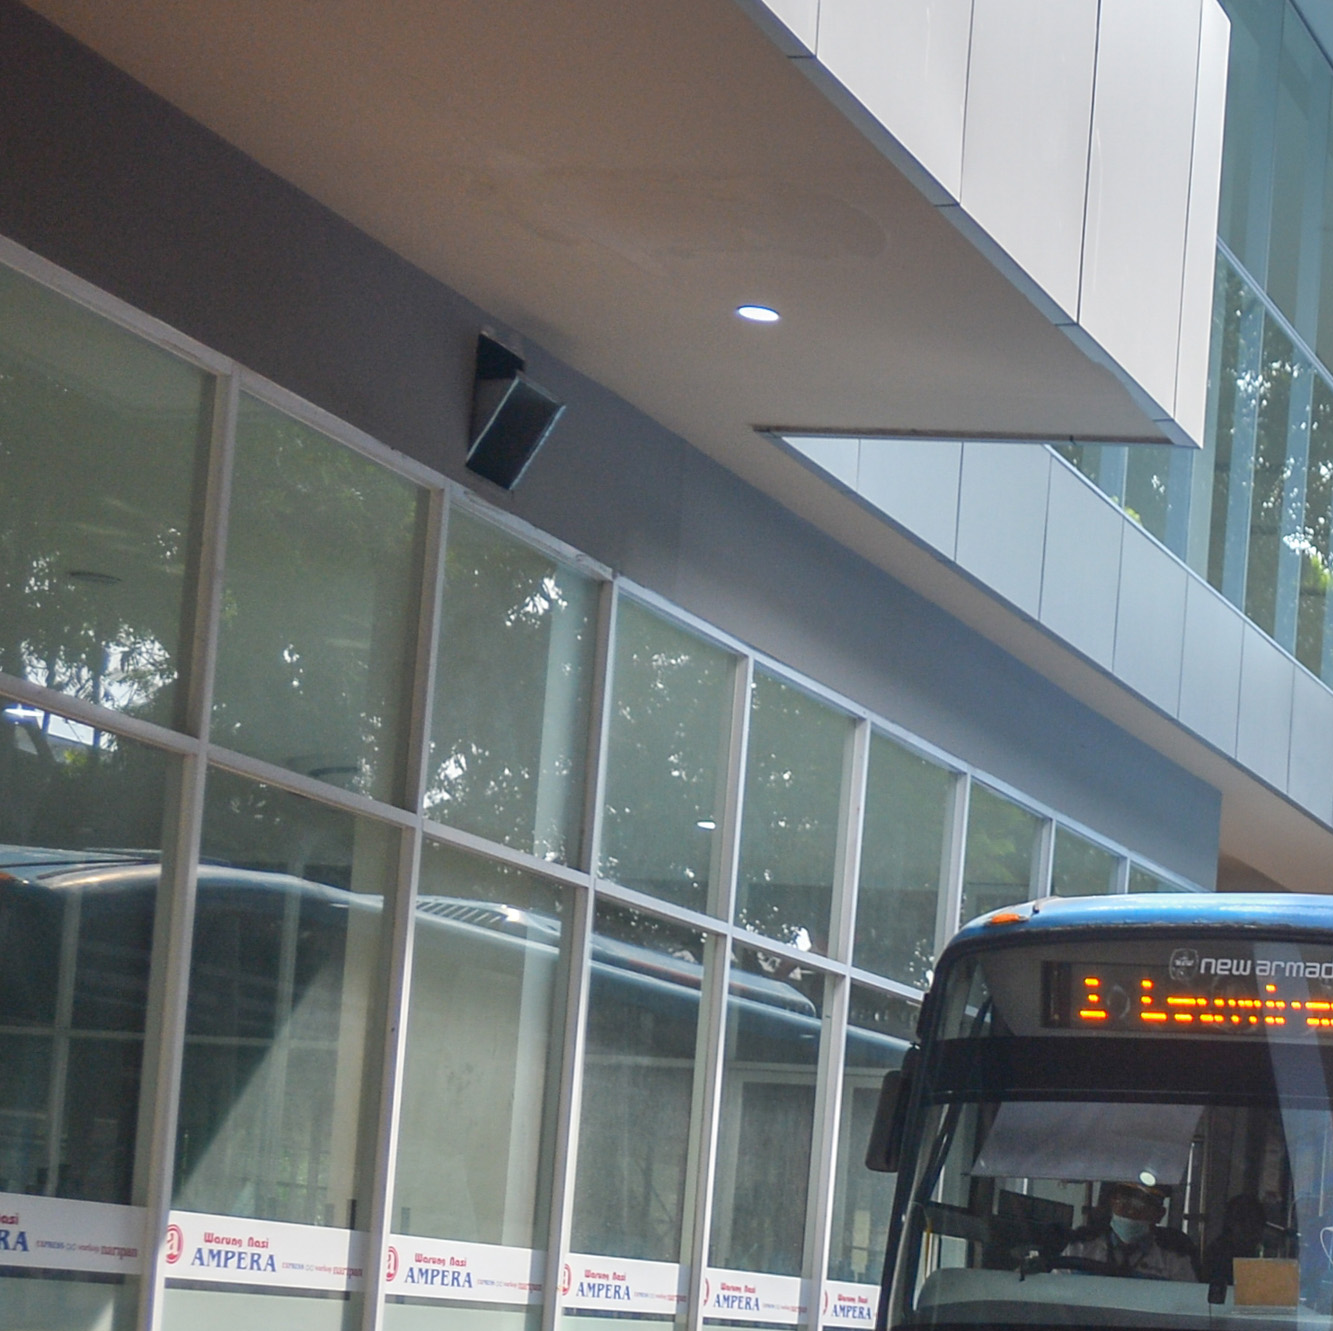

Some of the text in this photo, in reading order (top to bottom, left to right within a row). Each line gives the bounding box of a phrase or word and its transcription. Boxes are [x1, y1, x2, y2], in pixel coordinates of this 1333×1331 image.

[1200, 957, 1251, 975] new
[204, 1232, 269, 1249] Warung Nasi
[190, 1248, 277, 1273] AMPERA
[414, 1253, 467, 1267] Warung Nasi
[404, 1266, 473, 1288] AMPERA
[584, 1269, 610, 1281] Warung
[576, 1282, 631, 1301] AMPERA
[713, 1293, 760, 1311] AMPERA
[831, 1304, 872, 1321] AMPERA
